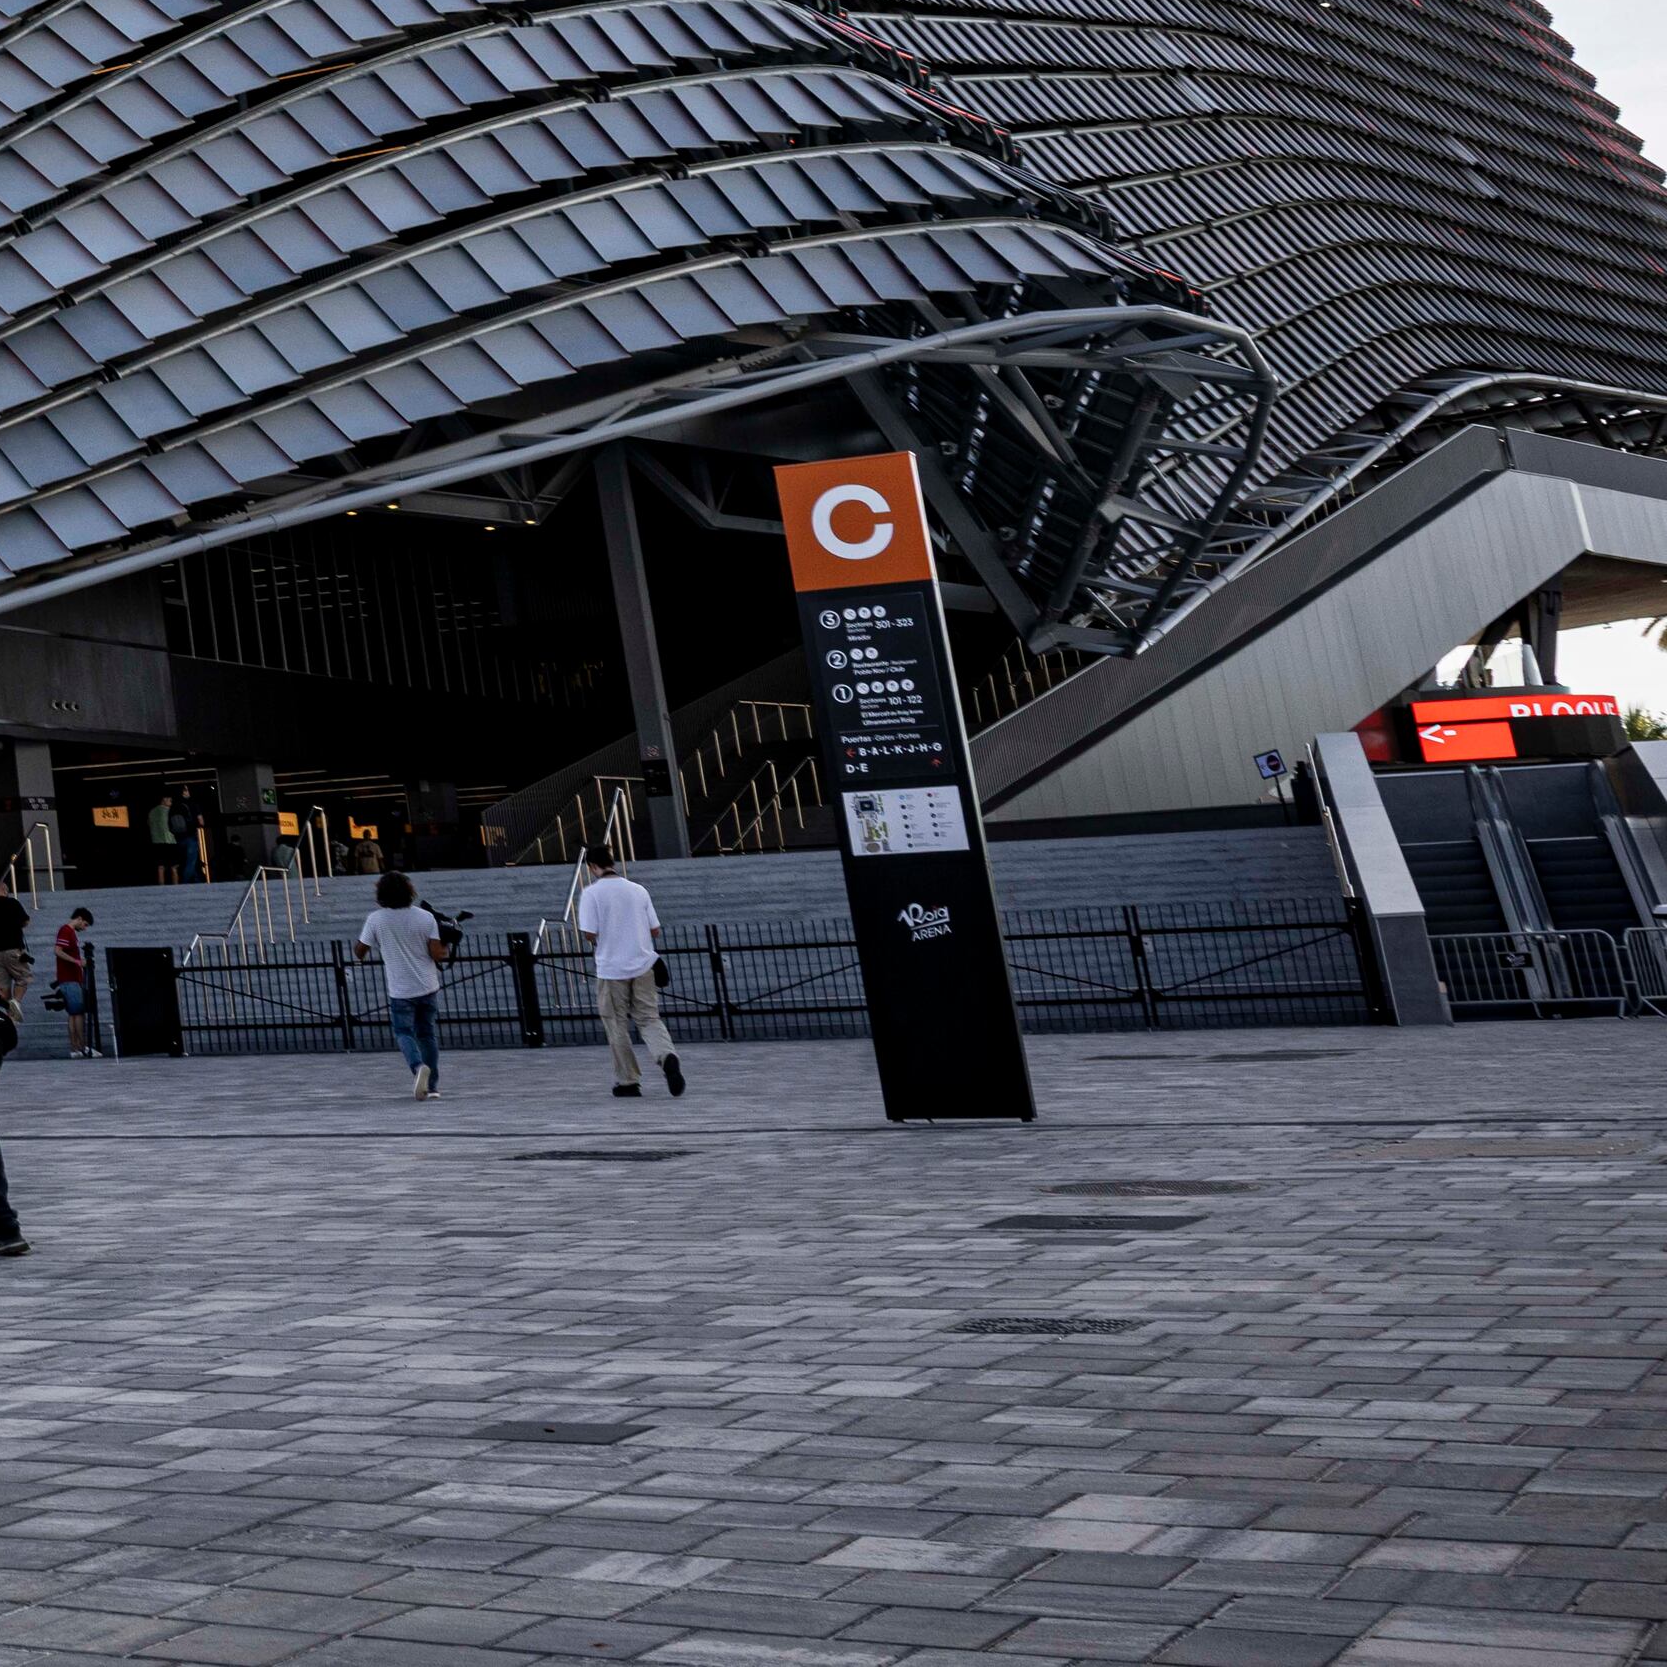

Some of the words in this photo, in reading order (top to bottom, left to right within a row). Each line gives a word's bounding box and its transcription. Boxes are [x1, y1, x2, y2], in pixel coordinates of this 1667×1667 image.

[811, 483, 895, 560] C
[897, 901, 951, 932] Roig
[910, 923, 953, 942] ARENA
